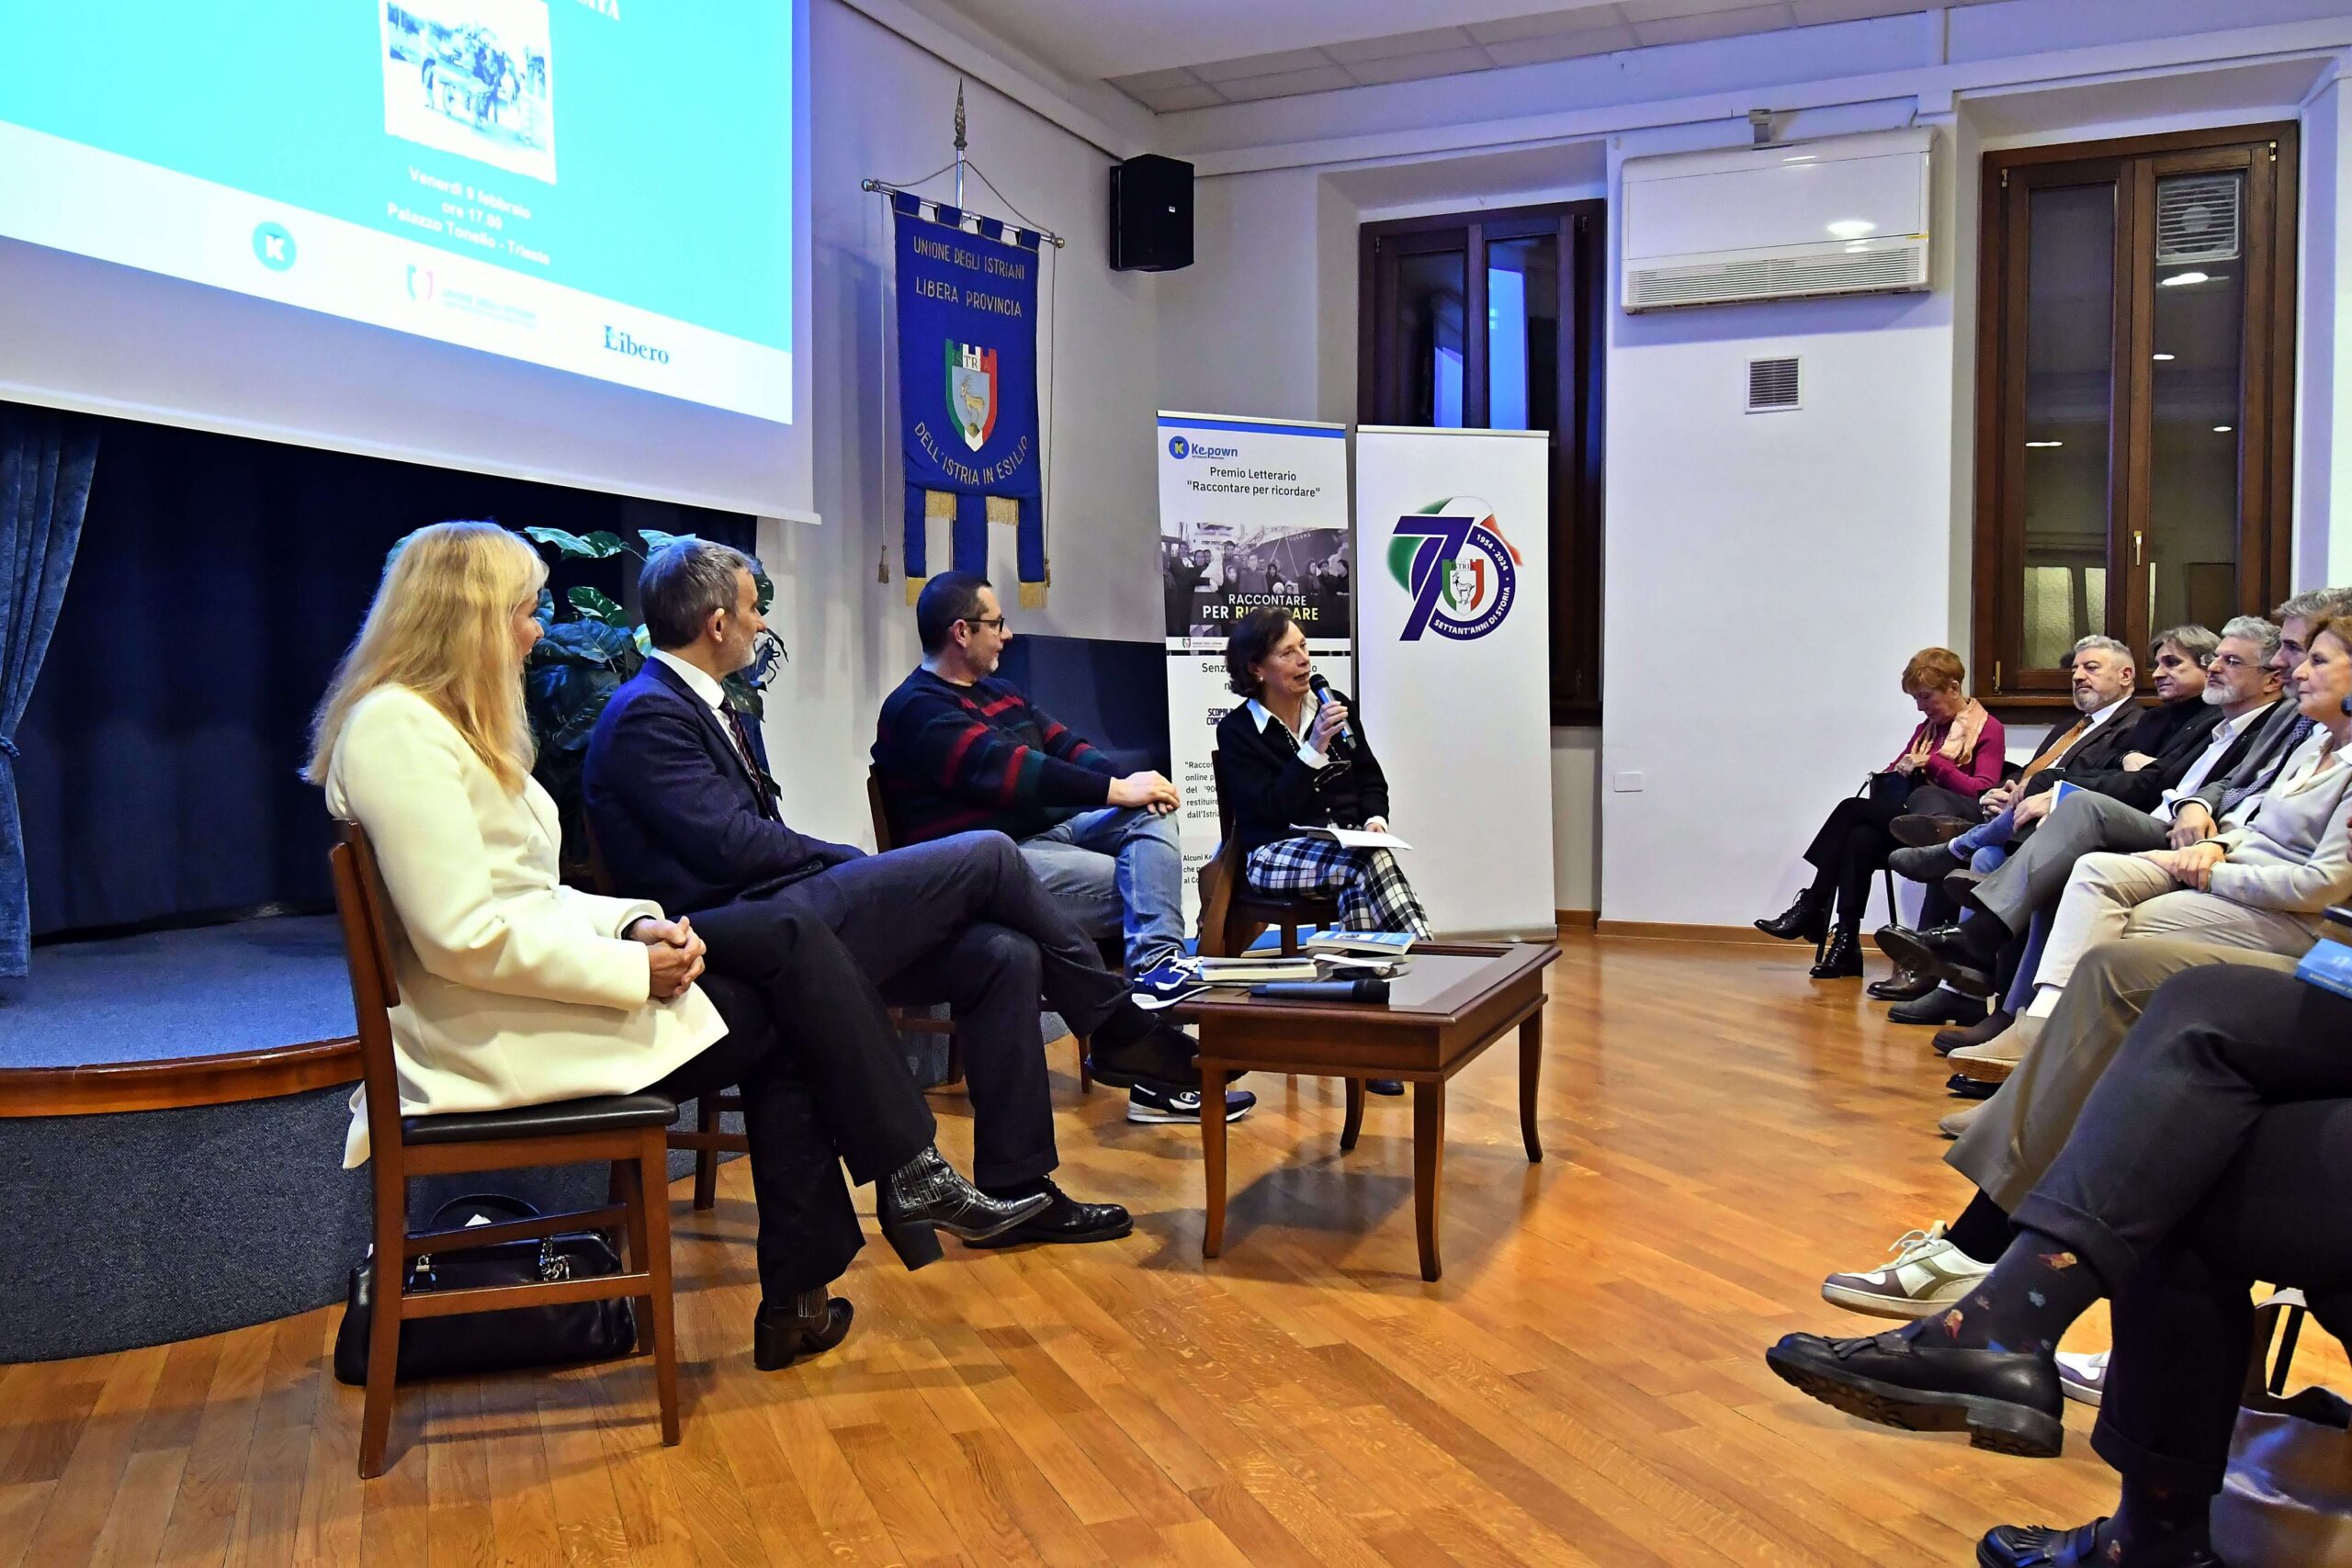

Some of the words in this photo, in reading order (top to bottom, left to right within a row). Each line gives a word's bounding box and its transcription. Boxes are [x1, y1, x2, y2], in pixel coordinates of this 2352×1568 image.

[441, 202, 464, 219] ore
[387, 201, 443, 231] Palazzo
[507, 239, 550, 265] Trieste
[913, 235, 950, 263] UNIONE
[954, 247, 980, 270] DEGLI
[984, 255, 1024, 280] ISTRIANI
[915, 276, 959, 304] LIBERA
[966, 289, 1023, 318] PROVINCIA
[603, 324, 670, 365] Libero
[952, 352, 989, 373] ISTRA
[983, 467, 994, 484] IN
[996, 434, 1028, 479] ESILIO
[1210, 466, 1246, 479] Premio
[1249, 468, 1297, 481] Letterario
[1187, 479, 1250, 494] "Raccontare
[1252, 485, 1269, 496] per
[1271, 484, 1320, 498] ricordare"
[1476, 534, 1494, 549] 1954
[1494, 551, 1509, 571] 2024
[1228, 593, 1306, 606] RACCONTARE
[1203, 605, 1229, 619] PER
[1235, 605, 1319, 621] RIARE
[1433, 618, 1490, 635] SETTANT'ANNI
[1488, 614, 1498, 625] DI
[1495, 586, 1511, 617] STORIA
[1202, 662, 1227, 673] Senz
[1185, 773, 1208, 782] online
[1204, 785, 1216, 794] '90
[1182, 865, 1195, 874] che
